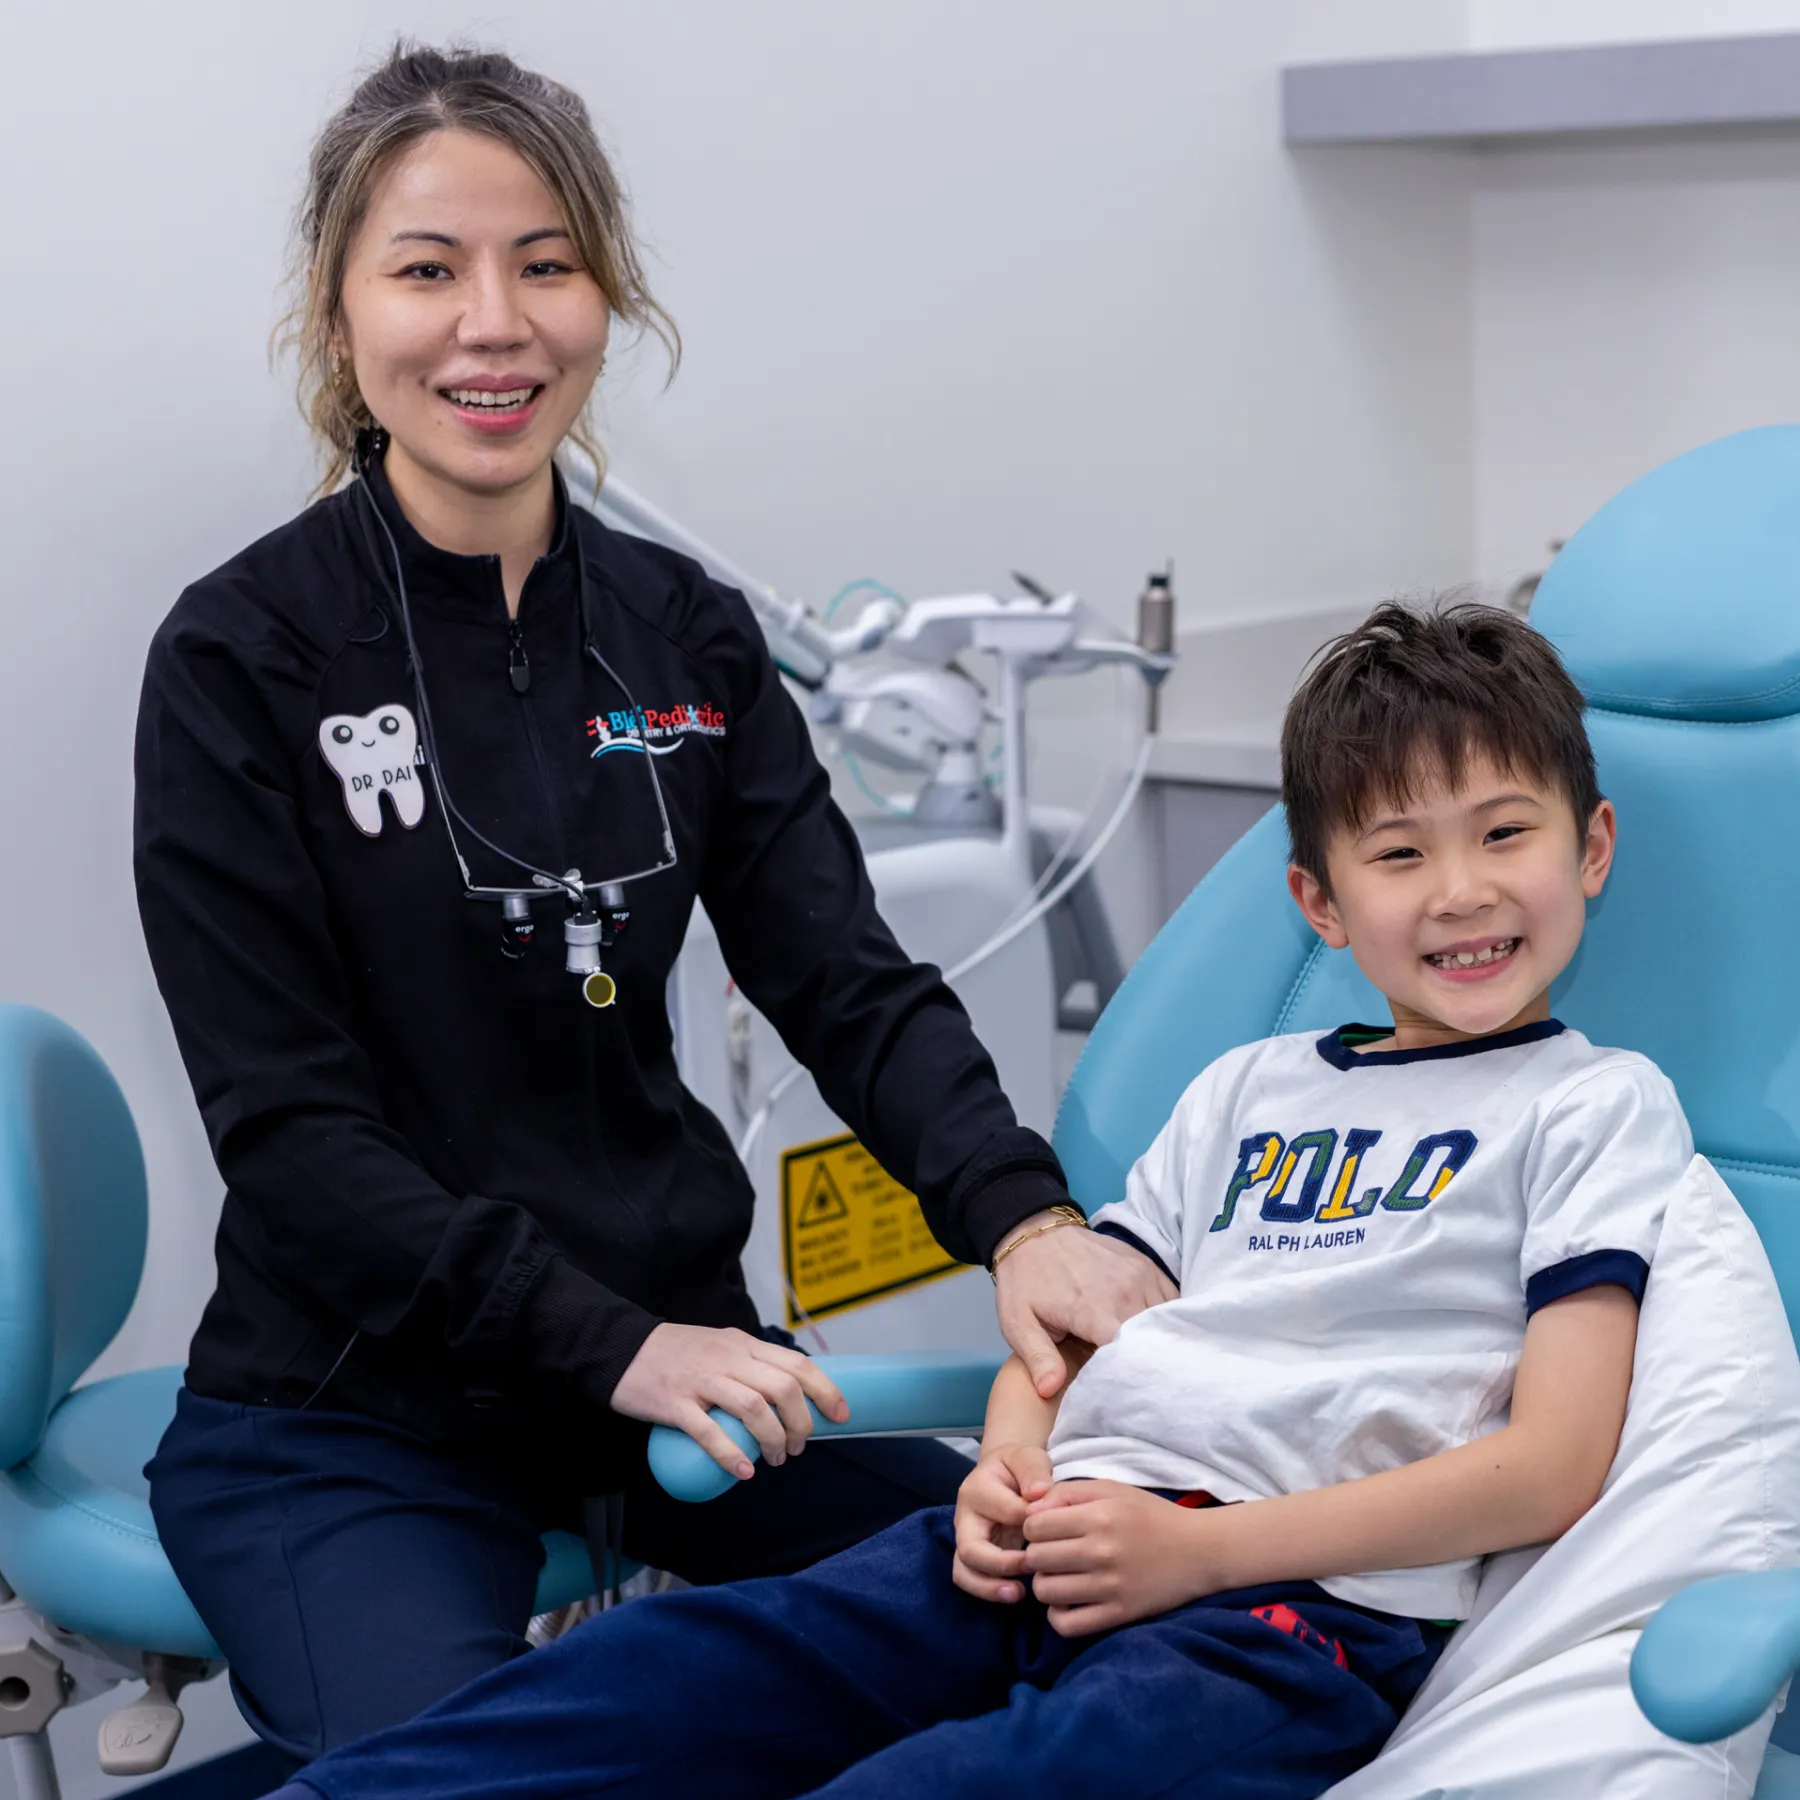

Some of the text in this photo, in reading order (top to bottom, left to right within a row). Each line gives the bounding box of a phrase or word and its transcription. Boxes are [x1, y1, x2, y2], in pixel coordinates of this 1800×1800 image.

[351, 765, 412, 792] DR DAI
[612, 911, 630, 921] ergo
[515, 925, 534, 934] ergo
[1208, 1127, 1479, 1233] POLO
[1247, 1227, 1366, 1252] RALPH LAUREN
